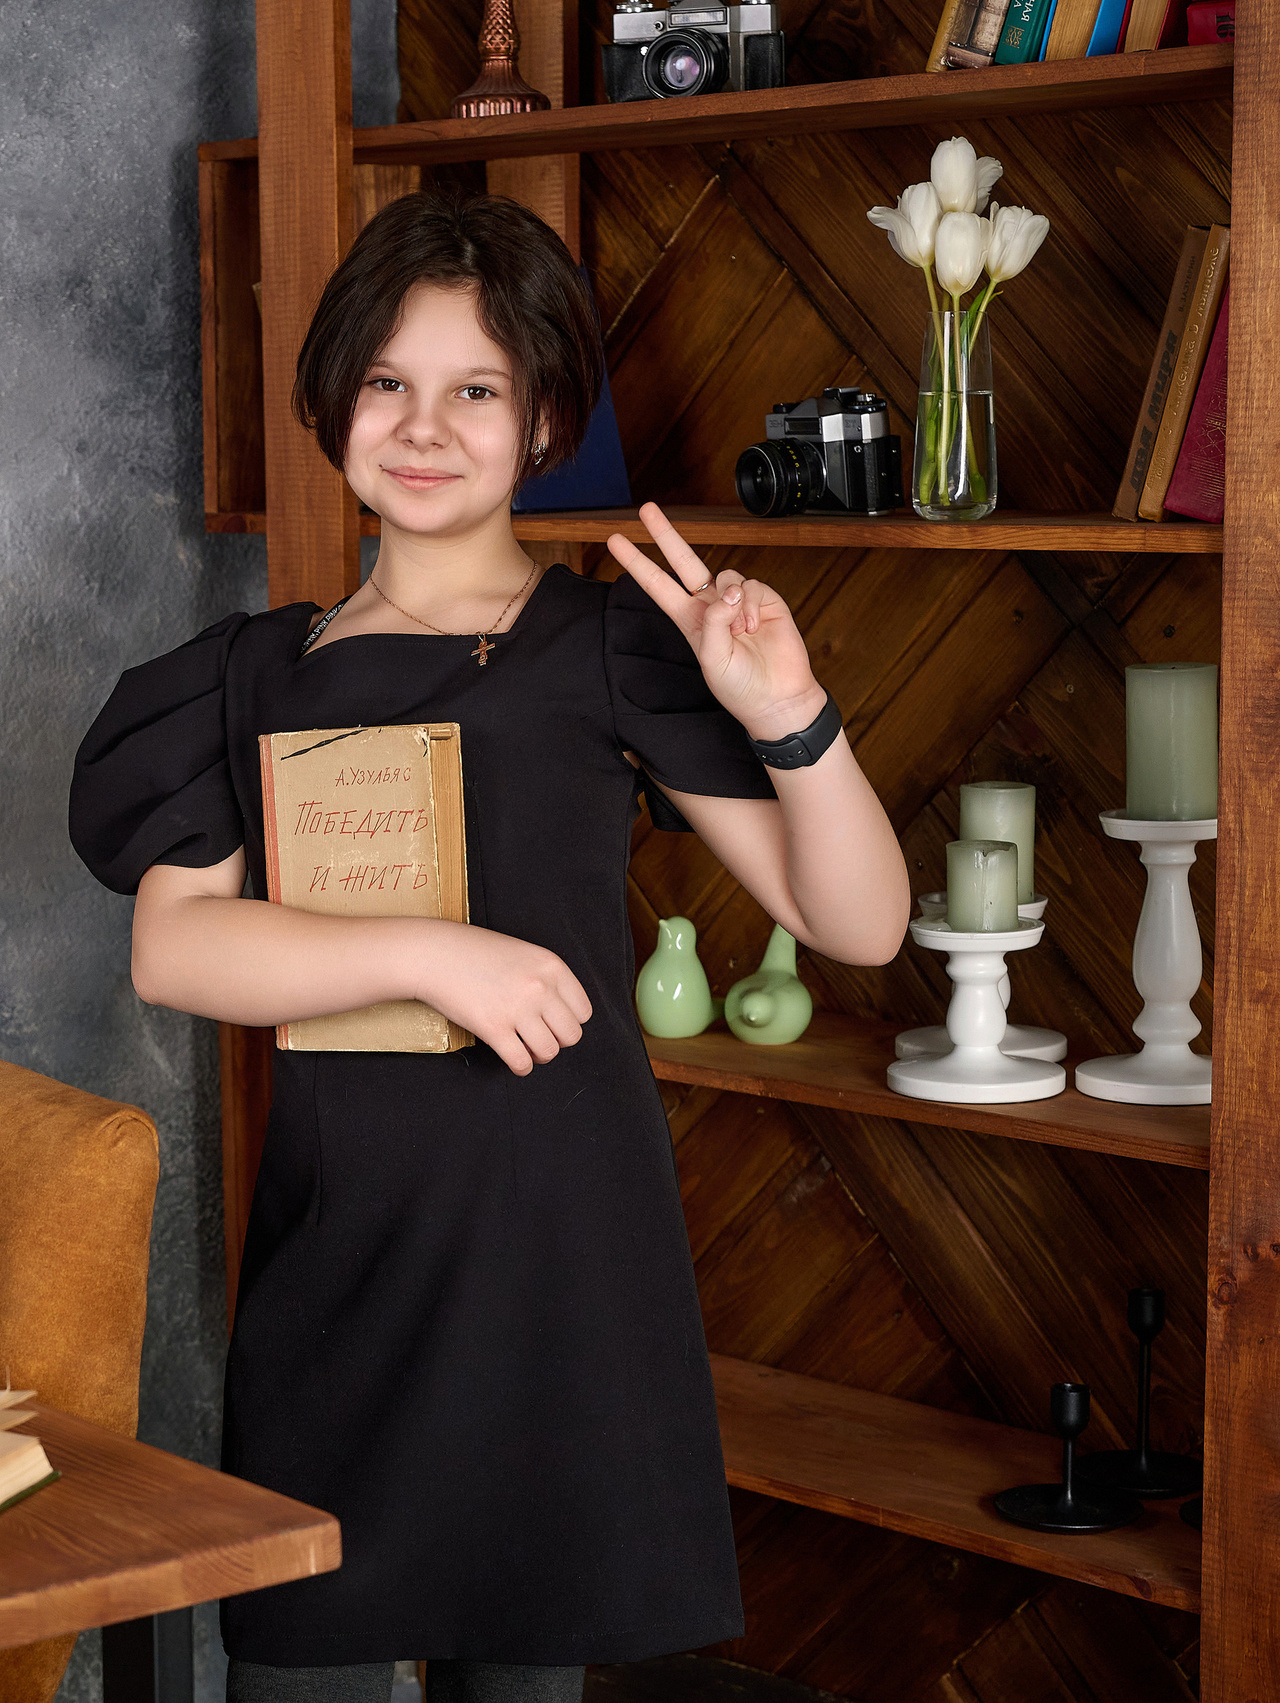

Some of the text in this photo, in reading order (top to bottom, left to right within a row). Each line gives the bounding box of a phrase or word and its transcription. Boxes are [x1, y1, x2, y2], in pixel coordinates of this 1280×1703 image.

[294, 800, 429, 840] ПОБЕДИТЬ
[309, 863, 428, 893] И ЖИТЬ
